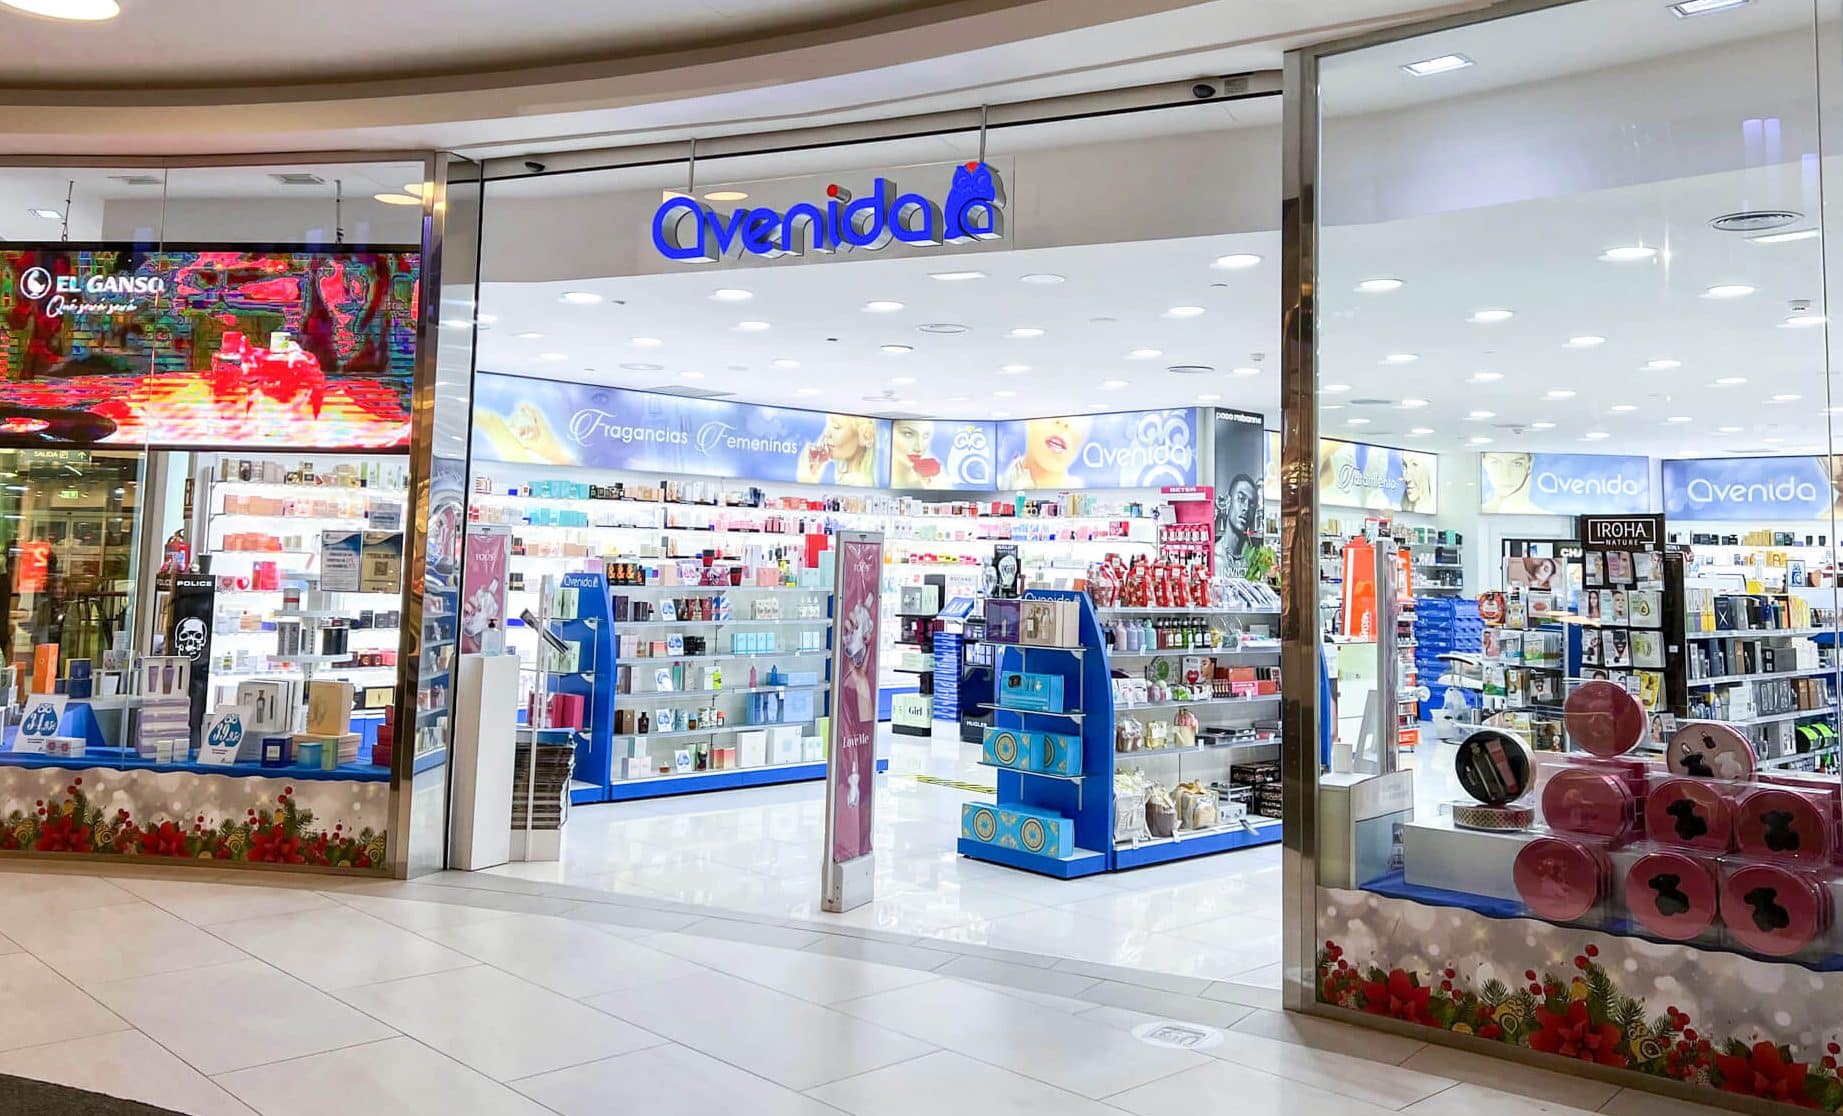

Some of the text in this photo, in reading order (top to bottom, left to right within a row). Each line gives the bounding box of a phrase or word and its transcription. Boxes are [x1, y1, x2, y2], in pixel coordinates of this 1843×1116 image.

[56, 276, 165, 293] EL GANSO
[567, 408, 798, 456] Fragancias Femeninas
[1597, 522, 1646, 538] IROHA
[908, 705, 922, 716] Girl
